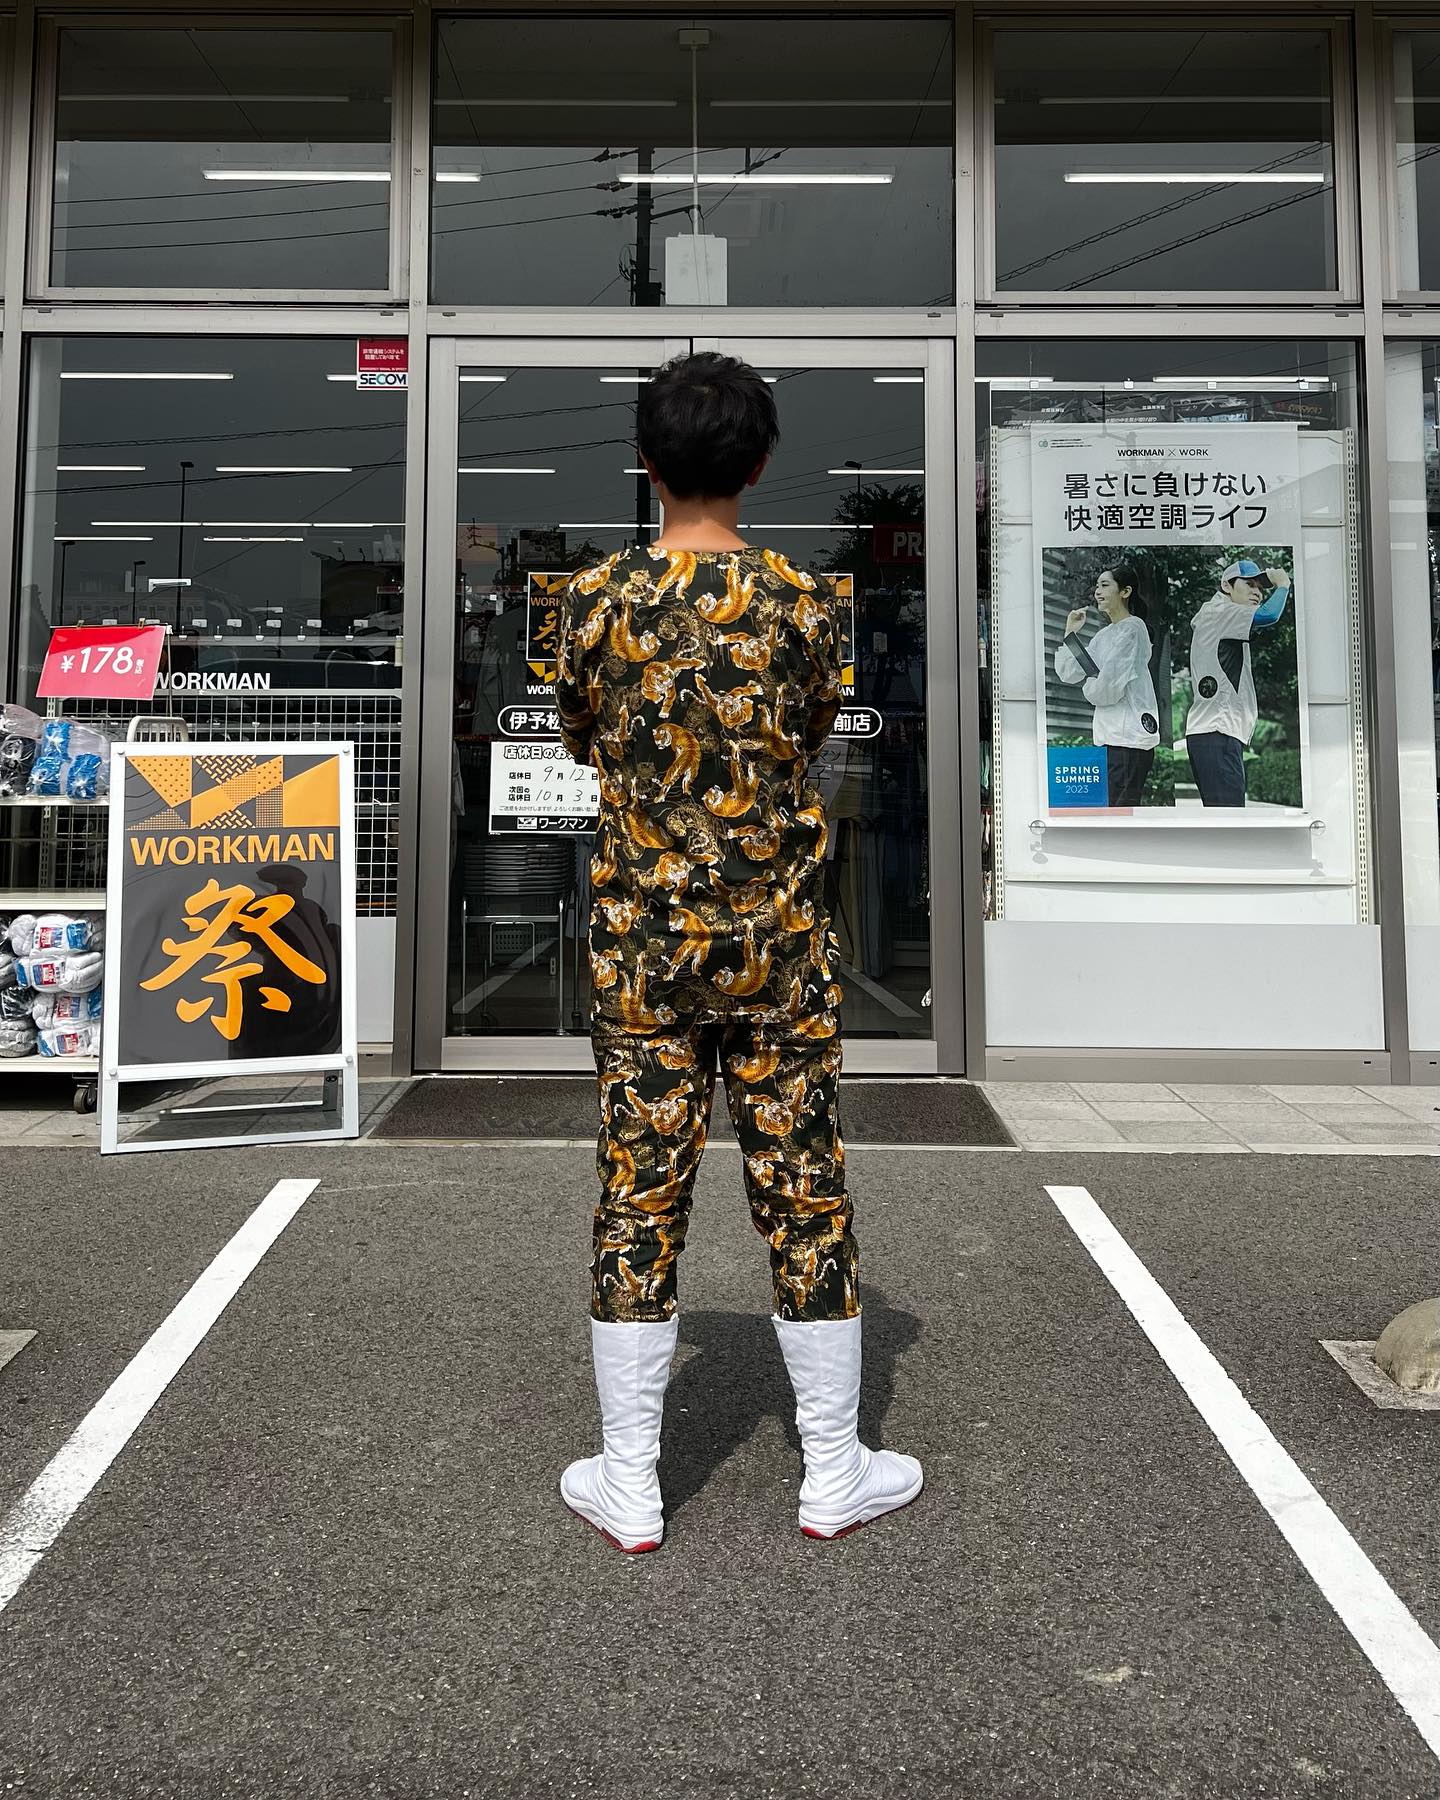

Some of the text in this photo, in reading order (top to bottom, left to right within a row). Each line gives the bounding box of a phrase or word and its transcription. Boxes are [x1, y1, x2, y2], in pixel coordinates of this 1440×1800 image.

[360, 374, 407, 385] SECOM
[1117, 448, 1165, 457] WORKMAN
[1179, 448, 1209, 457] WORK
[1063, 471, 1268, 499] 暑さに負けない
[1063, 503, 1268, 532] 快適空調ライフ
[892, 531, 926, 558] PR
[527, 685, 556, 695] WOR
[833, 713, 871, 732] 前店
[508, 765, 599, 783] 店休日 9 月 12 日
[1055, 766, 1100, 775] SPRING
[1055, 775, 1100, 784] SUMMER
[508, 785, 531, 794] 次回の
[508, 788, 598, 802] 店休日 10 月 3 日
[1065, 785, 1089, 794] 2023
[538, 816, 588, 830] ワークマン
[130, 832, 335, 866] WORKMAN
[138, 878, 327, 1041] 祭
